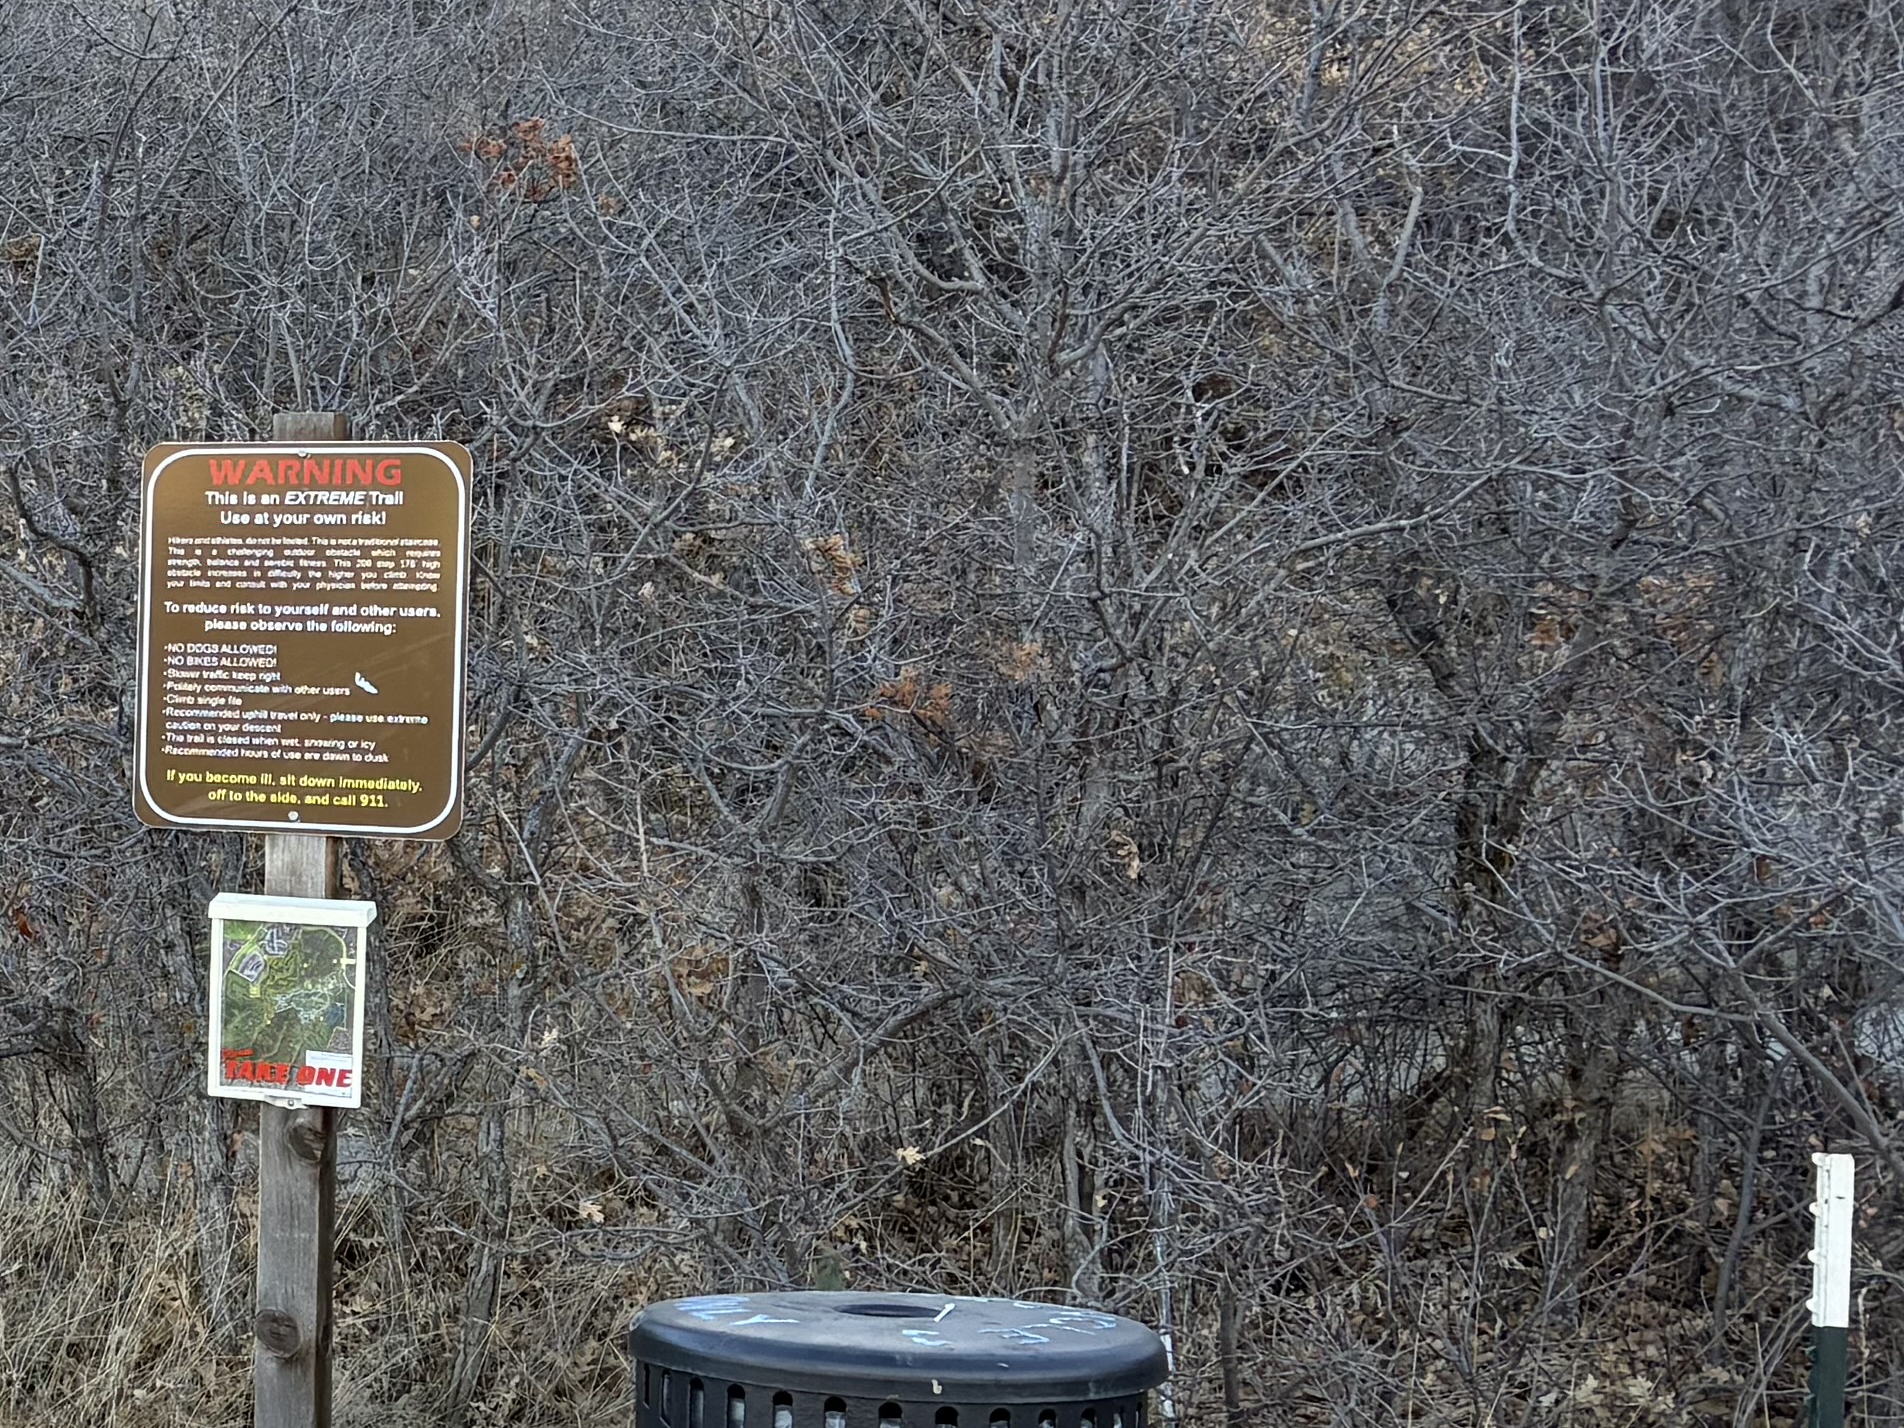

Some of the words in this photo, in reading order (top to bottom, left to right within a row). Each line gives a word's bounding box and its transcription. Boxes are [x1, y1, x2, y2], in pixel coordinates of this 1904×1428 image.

[209, 459, 402, 486] WARNING
[205, 491, 238, 505] This
[243, 491, 255, 505] is
[261, 493, 280, 505] an
[284, 491, 368, 505] EXTREME
[369, 491, 403, 505] Trail
[220, 511, 250, 524] Use
[254, 512, 269, 524] at
[273, 513, 310, 527] your
[313, 514, 346, 524] own
[351, 511, 386, 525] risk!
[312, 537, 329, 545] This
[329, 537, 337, 545] is
[168, 547, 185, 555] This
[227, 548, 274, 557] challenging
[406, 550, 441, 558] requires
[334, 559, 351, 567] This
[422, 560, 441, 570] high
[167, 569, 201, 577] obstacle
[207, 569, 247, 577] increases
[267, 569, 302, 579] difficulty
[308, 570, 322, 578] the
[328, 570, 355, 580] higher
[361, 572, 377, 580] you
[167, 580, 185, 588] your
[215, 580, 231, 588] and
[235, 580, 266, 588] consult
[270, 580, 288, 588] with
[292, 582, 311, 590] your
[316, 581, 356, 590] physician
[361, 582, 388, 590] before
[392, 583, 440, 592] attempting.
[164, 601, 180, 613] To
[182, 601, 227, 614] reduce
[230, 602, 255, 614] risk
[258, 603, 272, 615] to
[274, 603, 329, 617] yourself
[332, 603, 357, 616] and
[360, 604, 397, 616] other
[204, 618, 247, 632] please
[250, 619, 303, 631] observe
[306, 620, 328, 632] the
[331, 620, 397, 636] following:
[167, 643, 185, 654] NO
[186, 644, 219, 654] DOGS
[220, 644, 277, 655] ALLOWED!
[167, 655, 184, 666] NO
[186, 656, 219, 667] BIKES
[220, 657, 277, 668] ALLOWED!
[167, 668, 200, 679] Slower
[202, 669, 230, 679] traffic
[232, 670, 257, 682] keep
[259, 670, 281, 682] right
[166, 681, 202, 693] Politely
[204, 683, 270, 693] communicate
[272, 684, 293, 694] with
[294, 685, 320, 695] other
[323, 686, 351, 695] users
[166, 694, 195, 704] Climb
[197, 695, 225, 707] single
[227, 696, 243, 705] file
[165, 707, 240, 719] Recommended
[242, 708, 268, 720] uphill
[270, 709, 298, 720] travel
[299, 711, 321, 723] only
[329, 712, 363, 723] please
[365, 714, 384, 723] use
[386, 714, 429, 724] extreme
[165, 721, 201, 730] caution
[218, 723, 240, 733] your
[242, 723, 282, 733] descent
[166, 732, 184, 742] The
[186, 733, 205, 743] trail
[206, 734, 215, 744] is
[217, 735, 250, 745] closed
[251, 736, 279, 746] when
[303, 738, 346, 750] snowing
[347, 740, 359, 749] or
[360, 739, 377, 751] icy
[164, 745, 238, 757] Recommended
[240, 747, 269, 759] hours
[271, 749, 282, 759] of
[283, 751, 302, 760] use
[303, 752, 321, 760] are
[322, 752, 351, 761] dawn
[352, 753, 363, 762] to
[364, 753, 390, 762] dusk
[166, 769, 176, 780] If
[178, 772, 203, 784] you
[205, 771, 257, 785] become
[279, 773, 296, 787] sit
[298, 774, 336, 788] down
[208, 788, 227, 801] off
[229, 790, 243, 801] to
[245, 790, 267, 802] the
[304, 793, 330, 805] and
[332, 794, 356, 806] call
[359, 794, 389, 808] 911.
[224, 1060, 289, 1084] TAKE
[296, 1065, 353, 1088] ONE
